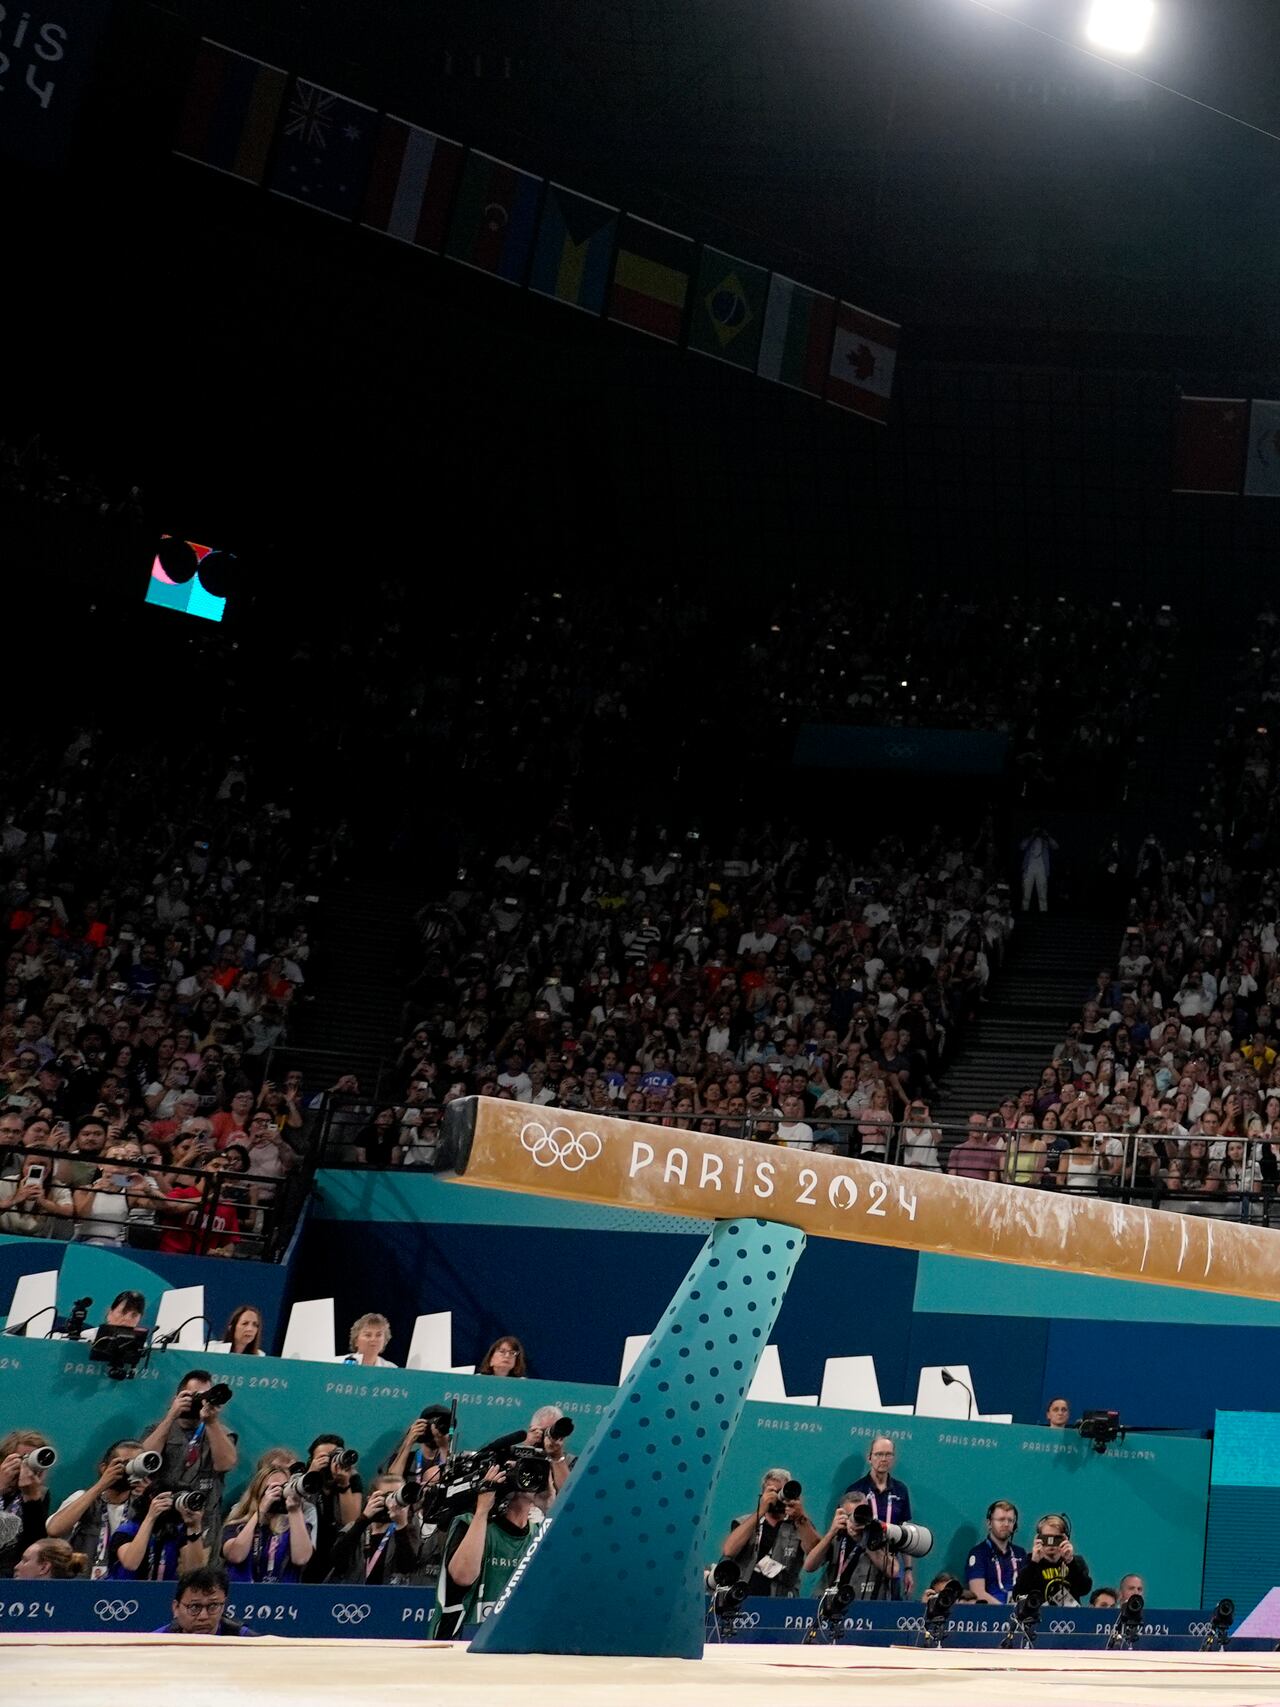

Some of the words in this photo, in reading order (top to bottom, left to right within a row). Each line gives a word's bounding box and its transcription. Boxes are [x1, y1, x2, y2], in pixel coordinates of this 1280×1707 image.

[796, 1168, 918, 1221] 2024
[211, 1374, 244, 1386] ARIS
[243, 1604, 299, 1620] 2024
[402, 1608, 436, 1622] PAR
[785, 1616, 828, 1630] PARS
[841, 1617, 873, 1630] 024
